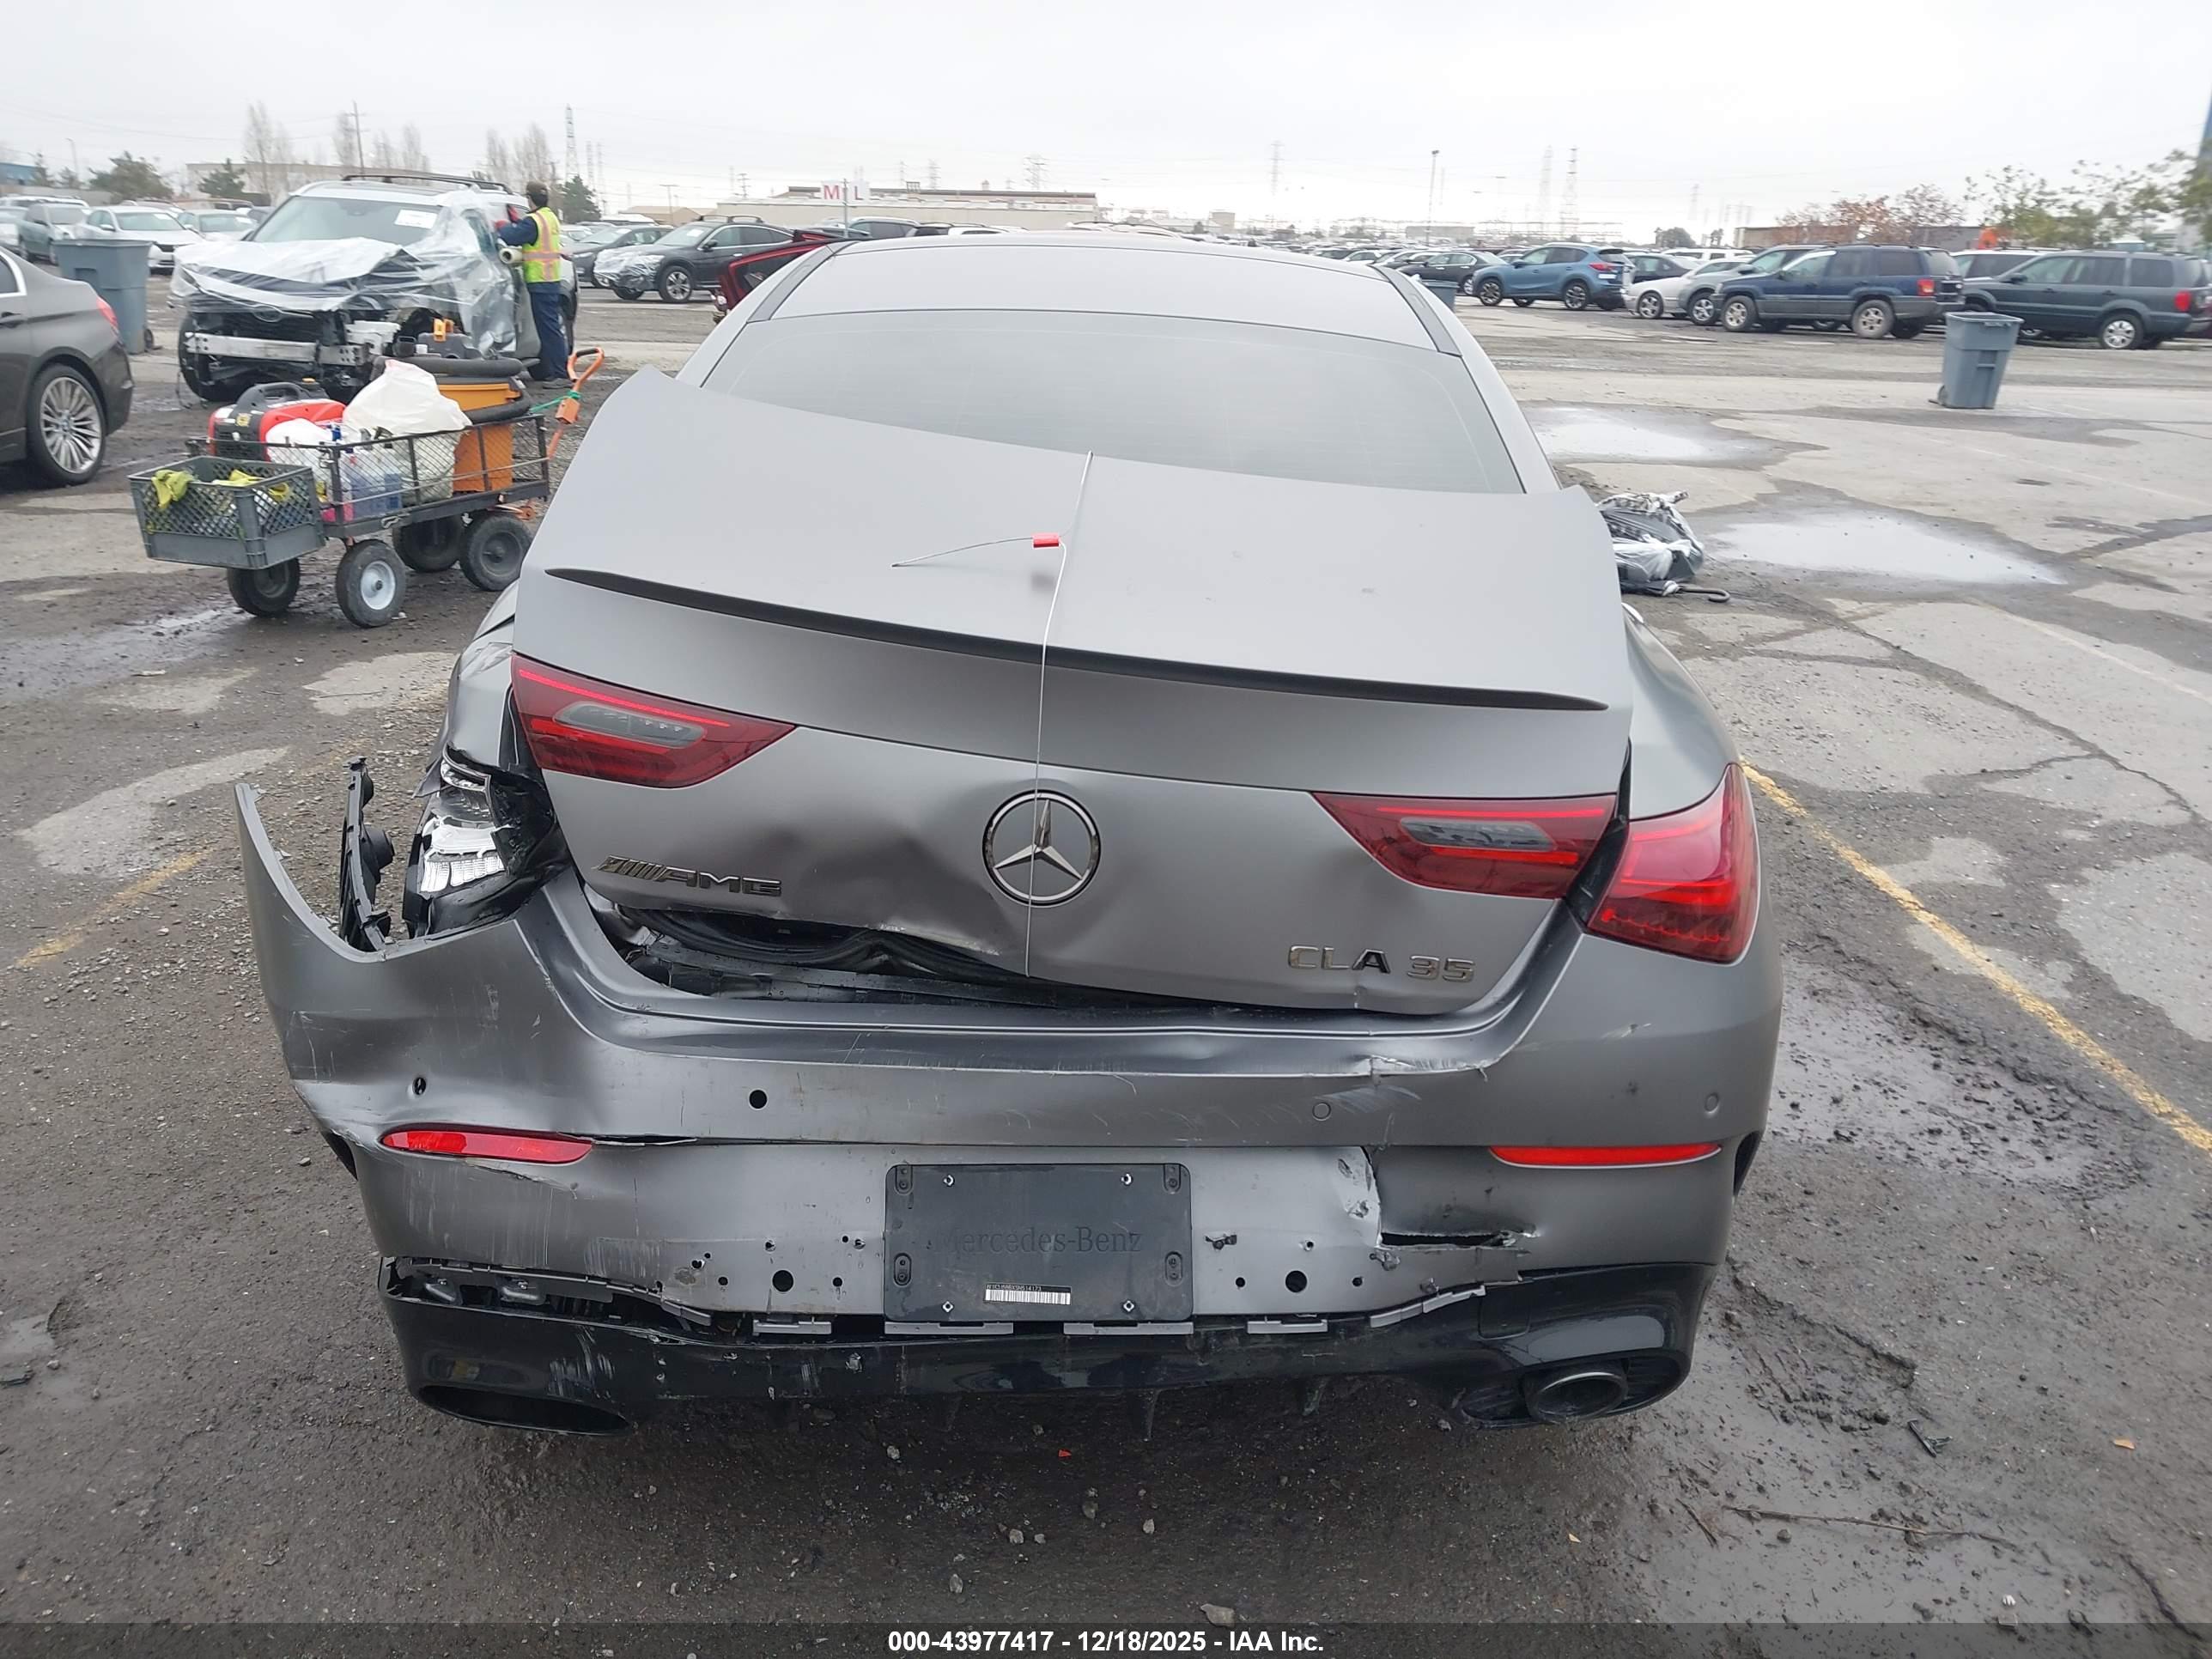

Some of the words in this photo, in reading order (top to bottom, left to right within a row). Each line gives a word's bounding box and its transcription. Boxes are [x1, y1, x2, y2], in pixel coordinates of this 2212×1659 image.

[823, 185, 840, 200] M
[655, 865, 782, 897] AMG
[1287, 944, 1391, 975] CLA
[1406, 954, 1475, 984] 35
[935, 1225, 1144, 1254] Mercedes-Benz
